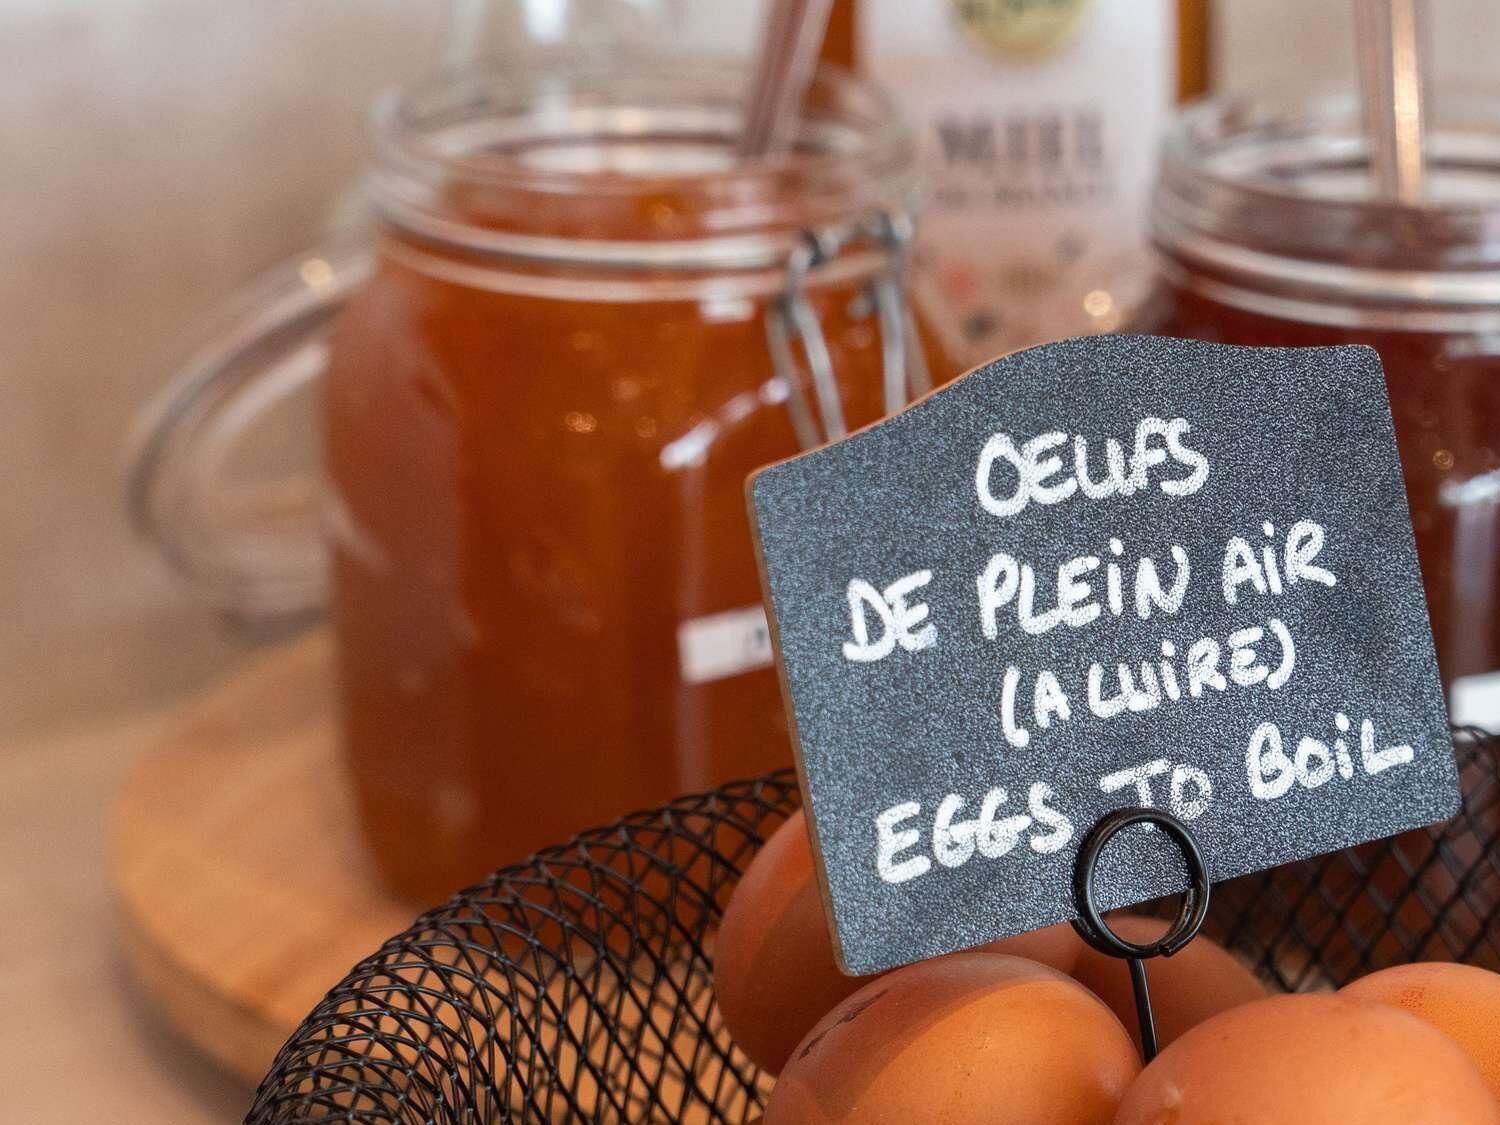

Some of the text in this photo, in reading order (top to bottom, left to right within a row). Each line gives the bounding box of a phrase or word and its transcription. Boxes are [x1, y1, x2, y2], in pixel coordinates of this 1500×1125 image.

[975, 416, 1210, 517] OEUFS
[843, 569, 938, 663] DE
[1000, 665, 1072, 749] (A
[874, 781, 1075, 885] EGGS
[1099, 757, 1214, 831] TO
